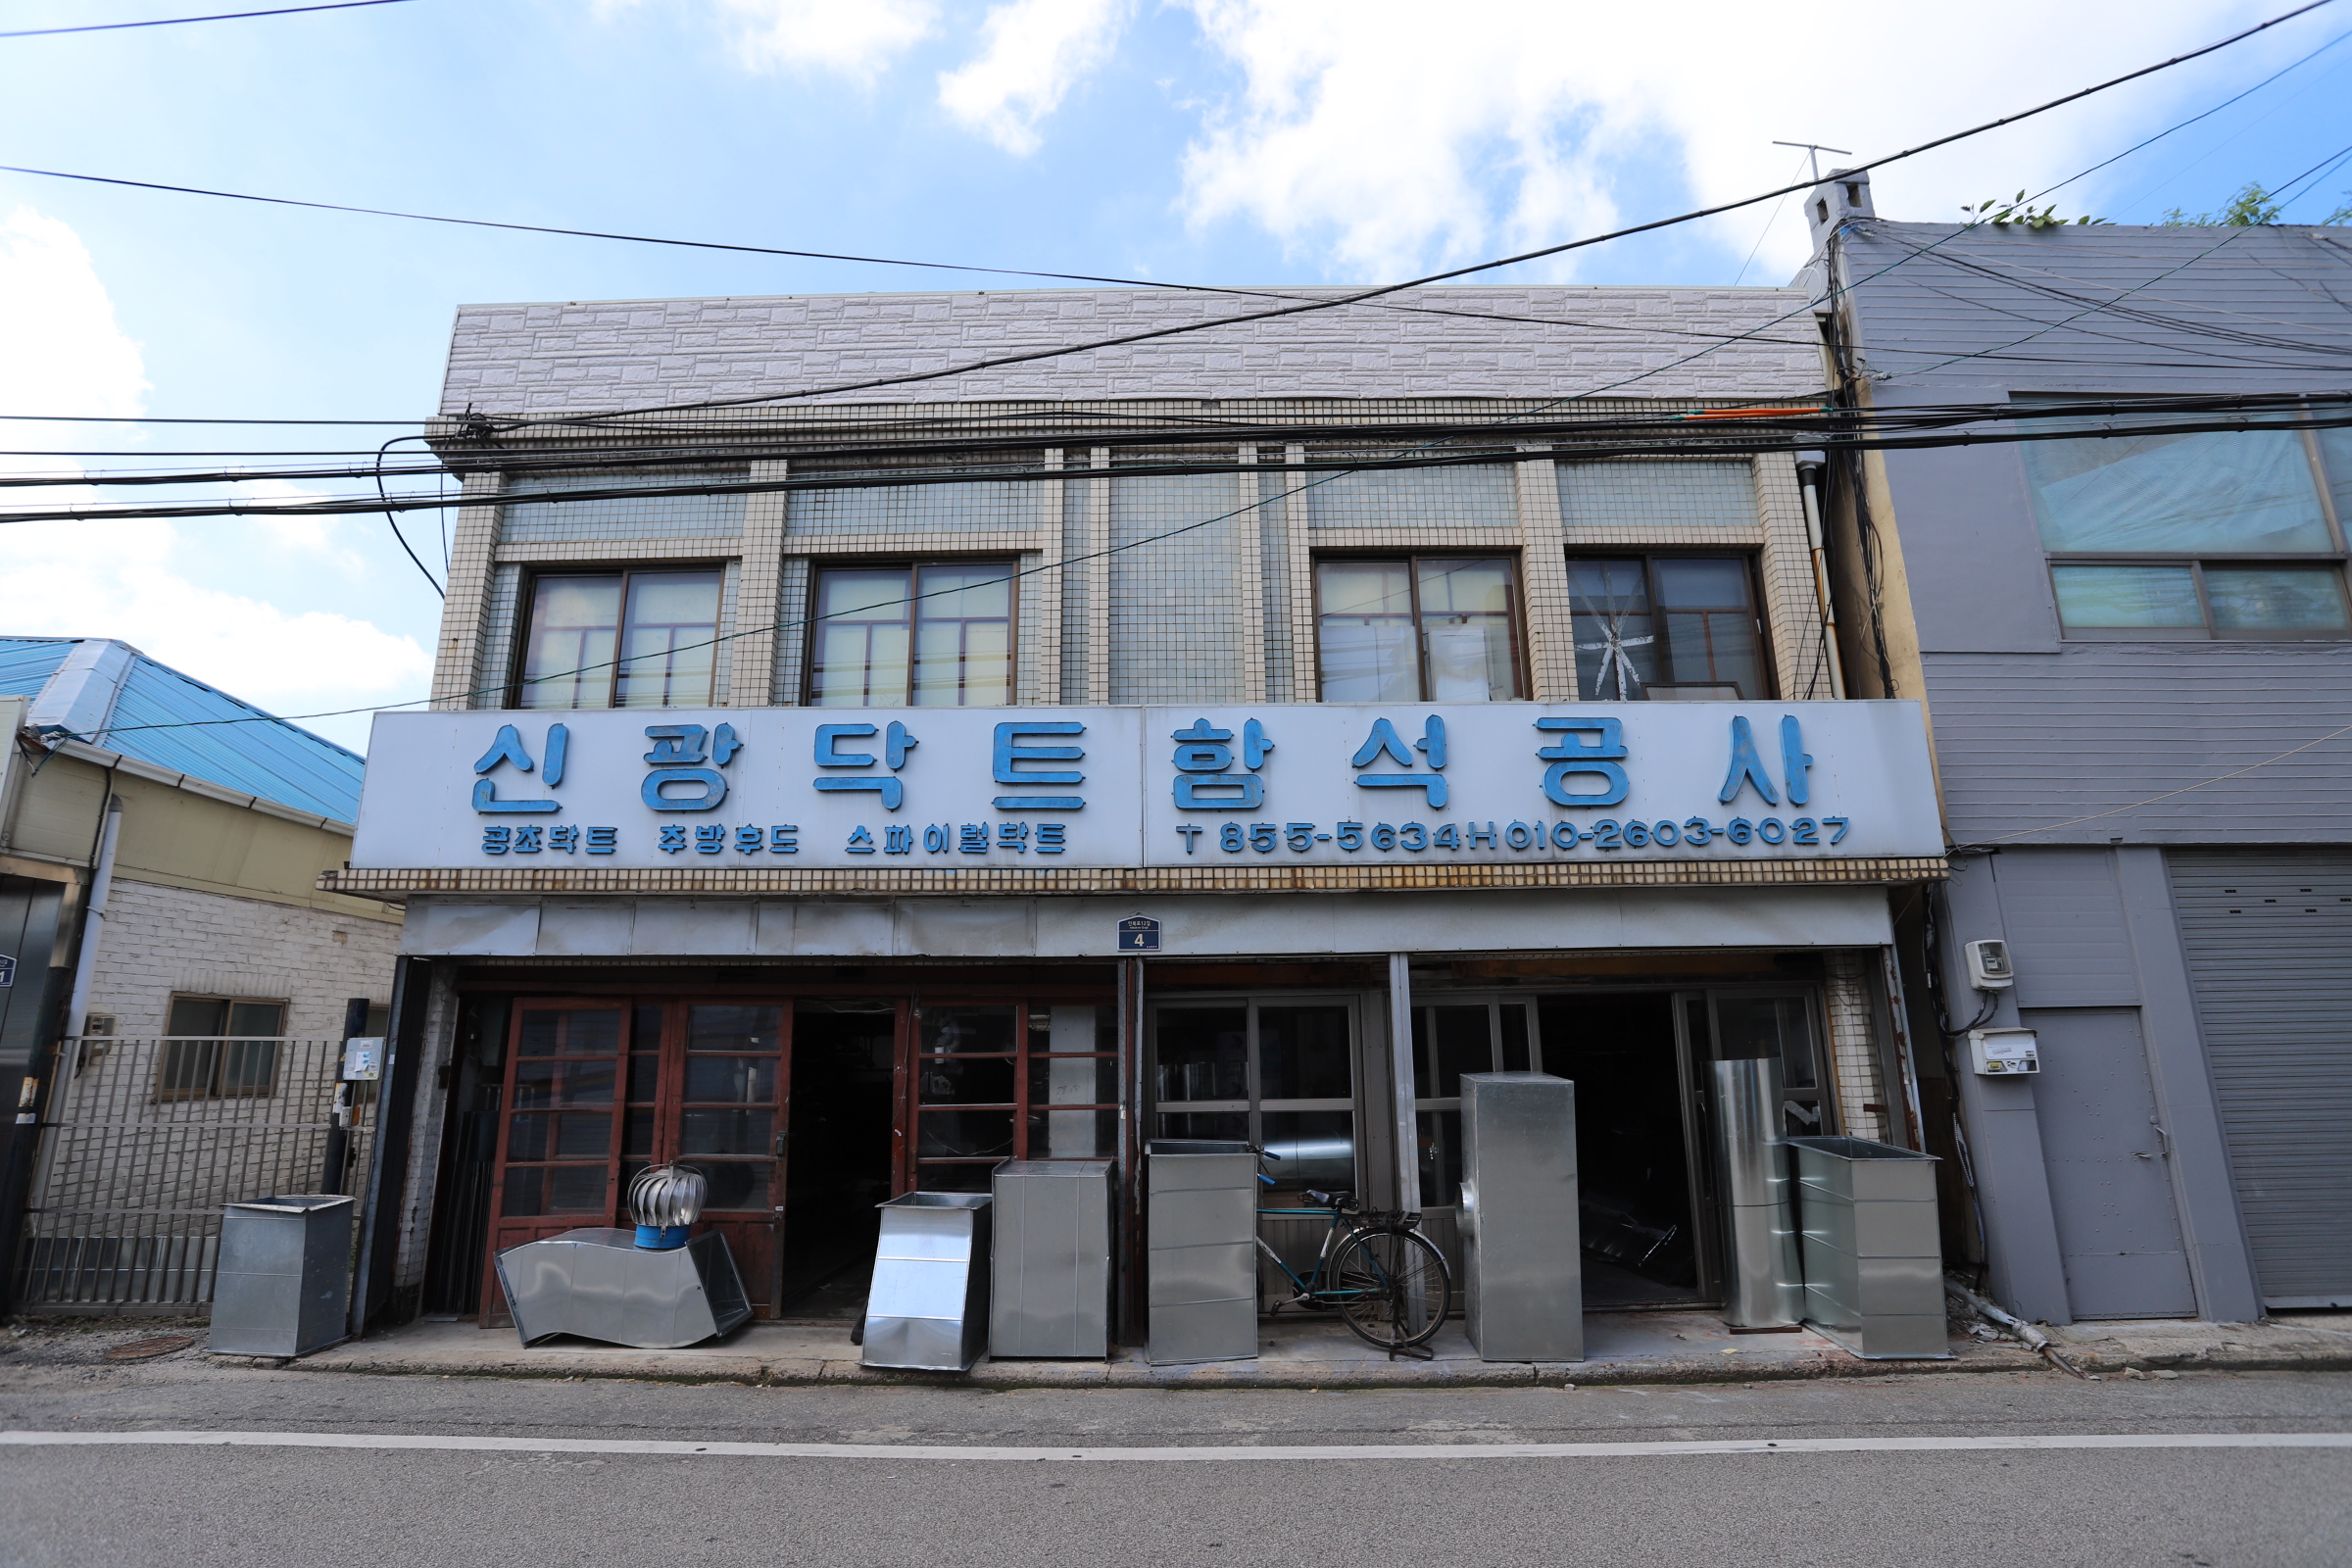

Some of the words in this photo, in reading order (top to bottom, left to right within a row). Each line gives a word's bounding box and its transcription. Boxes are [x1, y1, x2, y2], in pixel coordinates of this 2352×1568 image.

[480, 823, 618, 856] 공조닥트
[658, 823, 801, 856] 주방후드
[844, 821, 1067, 856] 스파이럴닥트
[1175, 823, 1204, 856] T
[1134, 933, 1145, 947] 4
